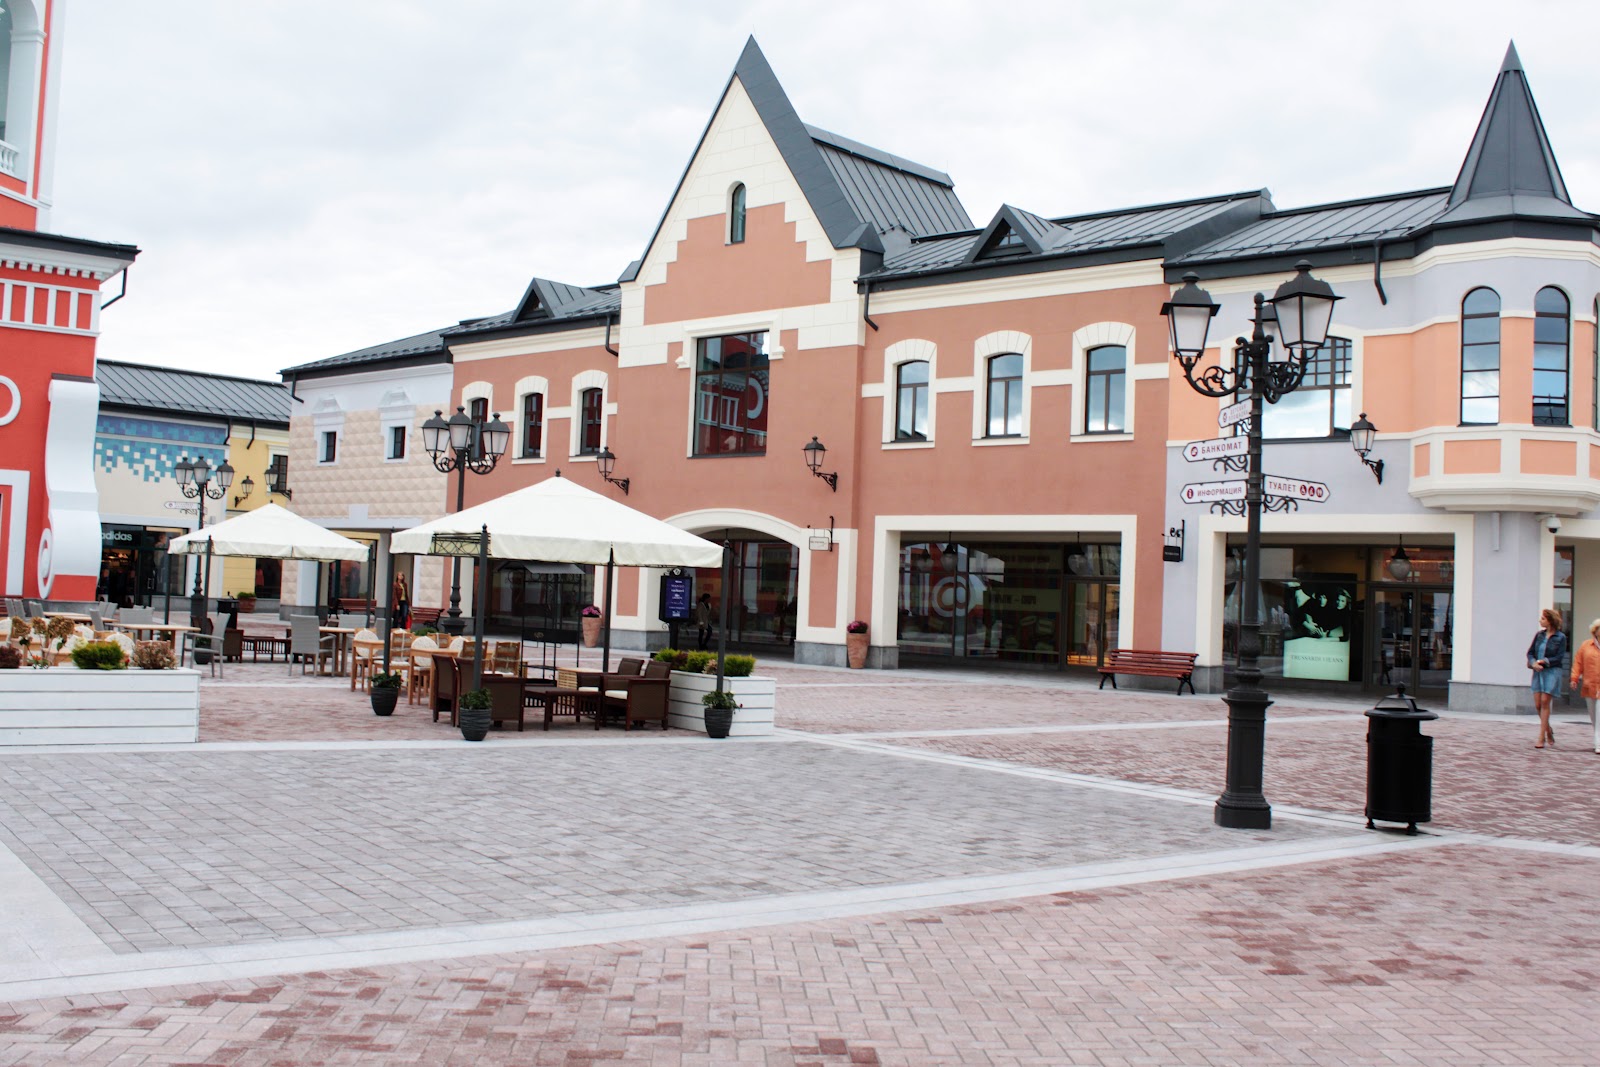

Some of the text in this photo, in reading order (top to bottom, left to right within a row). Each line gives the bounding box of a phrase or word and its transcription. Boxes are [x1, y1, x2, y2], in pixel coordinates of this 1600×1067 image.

[1202, 441, 1242, 454] БАНКОМАТ
[1197, 486, 1242, 497] ИНФОРМАЦИЯ
[1268, 481, 1297, 493] ТУАЛЕТ
